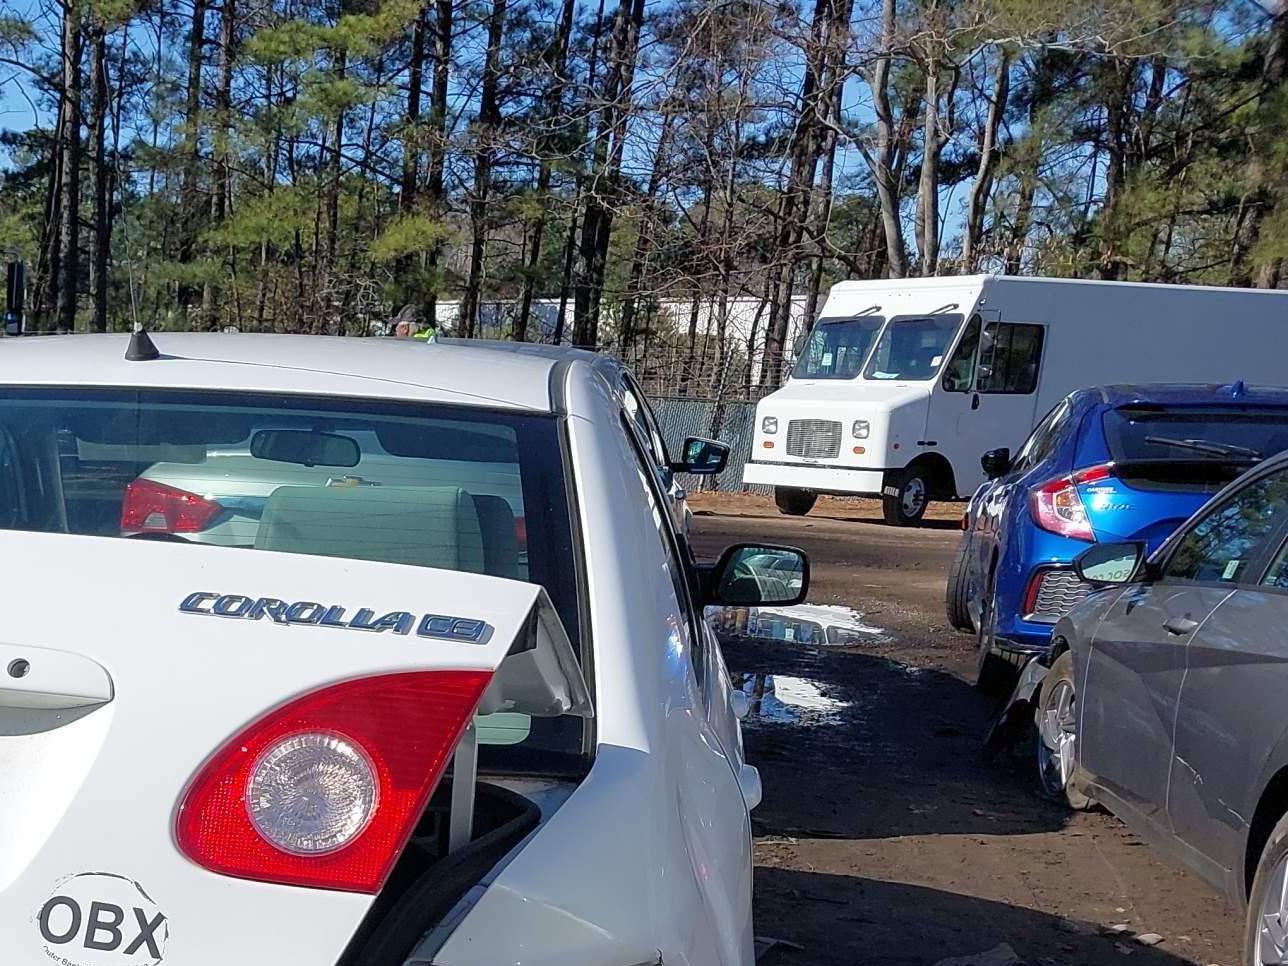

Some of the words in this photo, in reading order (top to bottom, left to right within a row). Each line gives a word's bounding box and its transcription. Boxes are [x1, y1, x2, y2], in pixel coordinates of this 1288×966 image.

[178, 591, 416, 636] COROLLA
[419, 615, 485, 642] CE
[39, 895, 168, 960] OBX
